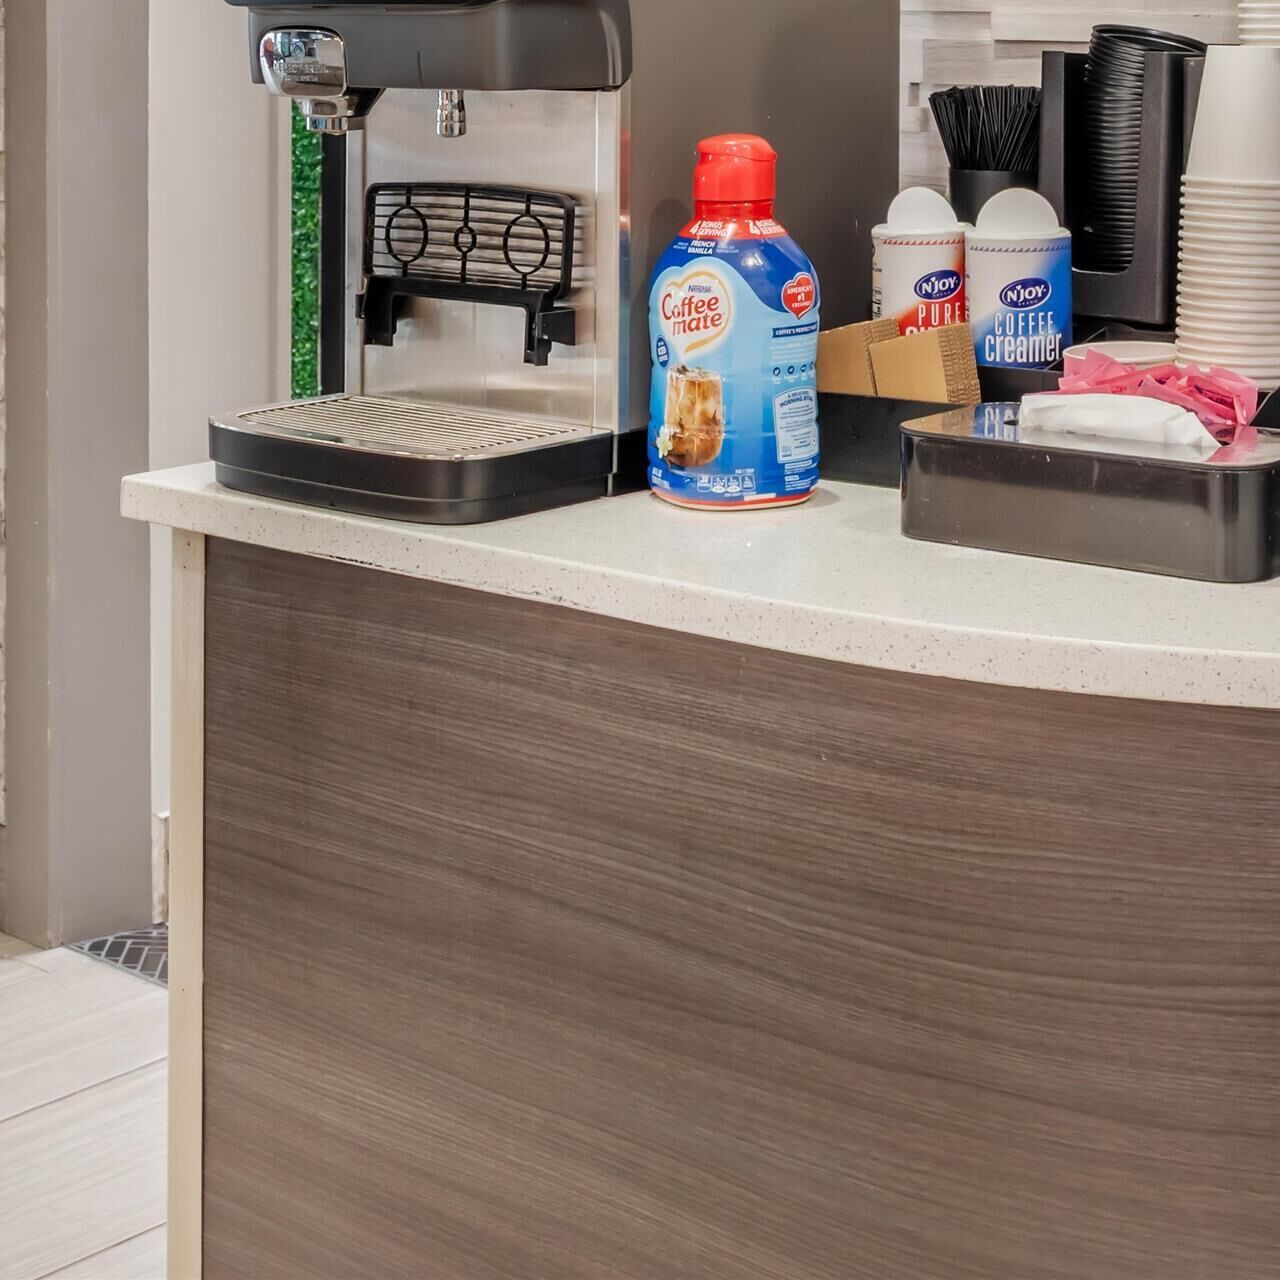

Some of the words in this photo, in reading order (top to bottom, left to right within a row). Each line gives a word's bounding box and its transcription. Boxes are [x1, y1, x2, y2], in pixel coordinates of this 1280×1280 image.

[687, 247, 713, 255] VANILLA
[690, 240, 715, 248] FRENCH
[661, 292, 719, 321] Coffee
[918, 303, 961, 326] PURE
[672, 312, 722, 336] mate
[994, 311, 1053, 335] COFFEE
[985, 332, 1062, 363] creamer
